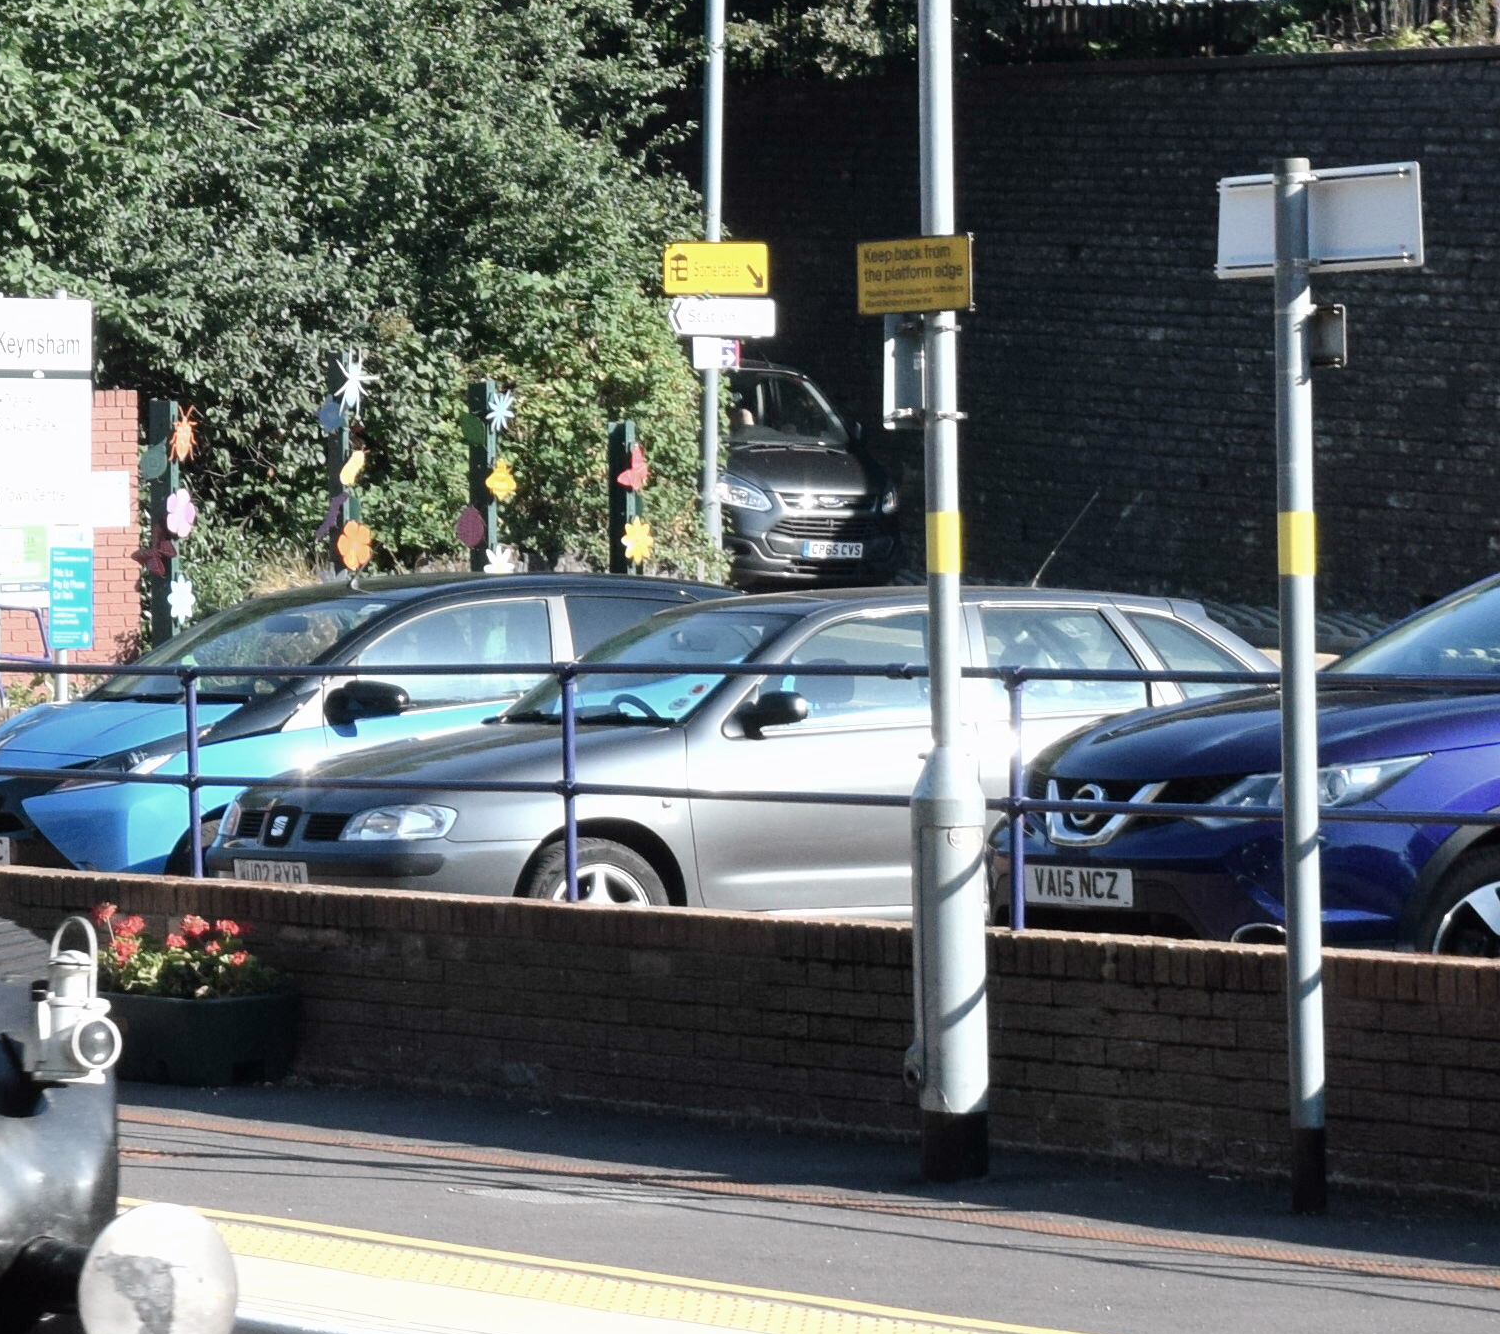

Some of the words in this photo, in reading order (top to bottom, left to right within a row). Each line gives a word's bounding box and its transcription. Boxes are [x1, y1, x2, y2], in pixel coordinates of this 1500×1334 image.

[864, 248, 892, 265] Keep
[895, 246, 922, 262] back
[924, 244, 950, 259] from
[864, 268, 882, 283] the
[885, 266, 931, 283] platform
[935, 263, 963, 280] edge
[687, 309, 737, 323] Staton
[841, 544, 861, 556] CVS
[1034, 868, 1075, 897] VA15
[1079, 870, 1119, 900] NCZ
